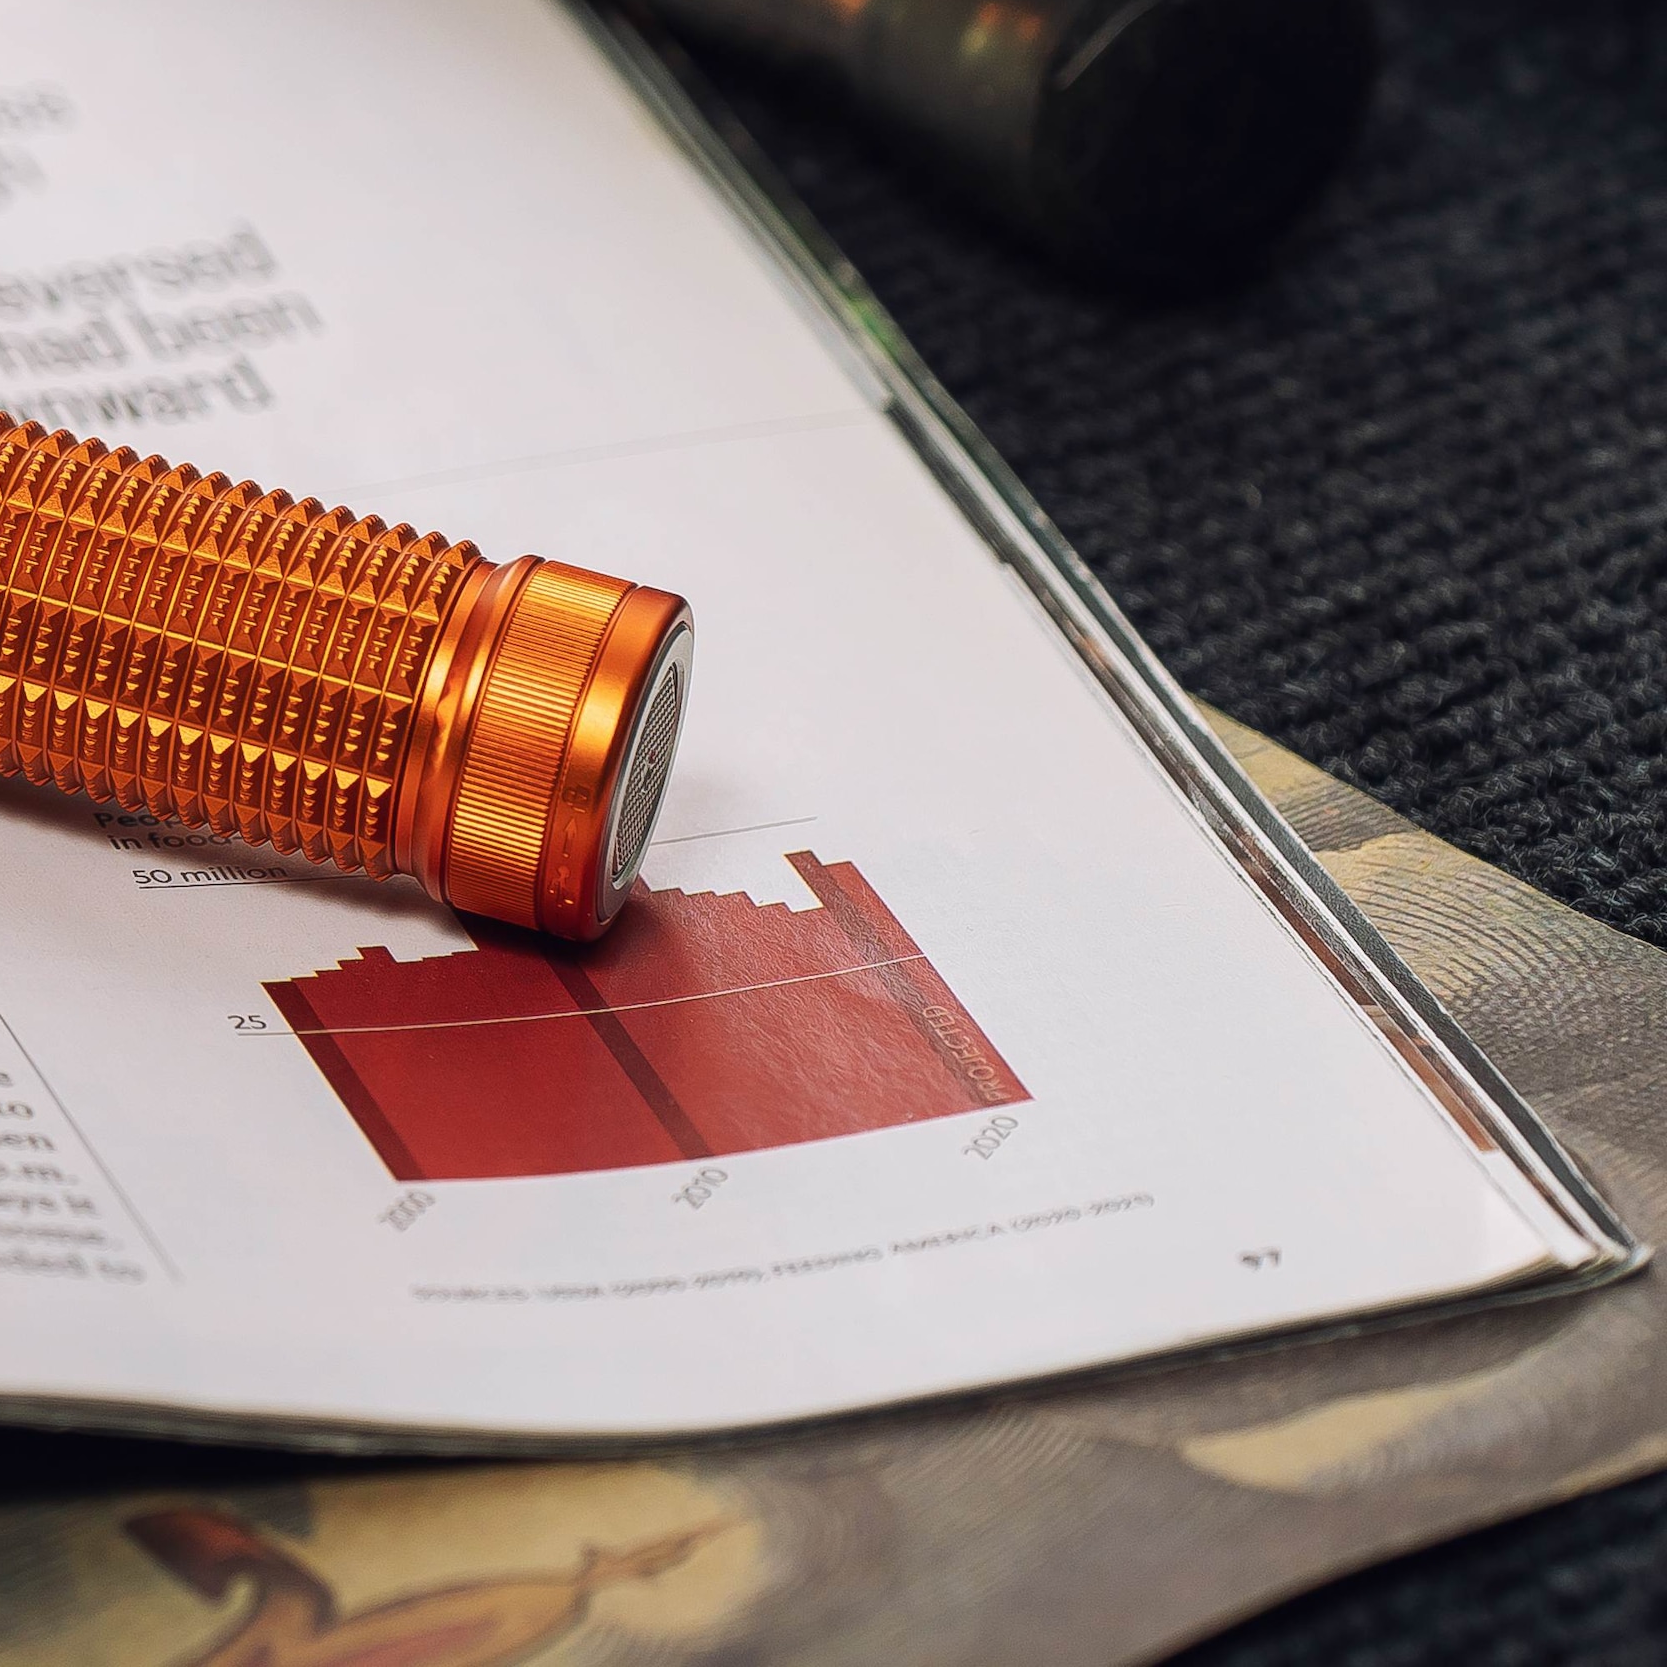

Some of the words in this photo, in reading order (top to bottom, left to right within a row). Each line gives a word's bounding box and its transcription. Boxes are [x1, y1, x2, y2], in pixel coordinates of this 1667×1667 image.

[110, 834, 143, 851] in
[131, 868, 173, 885] 50
[179, 865, 289, 884] million
[226, 1014, 268, 1030] 25
[922, 1004, 1012, 1103] PROJECTED
[963, 1115, 1020, 1161] 2020
[670, 1165, 729, 1210] 2010
